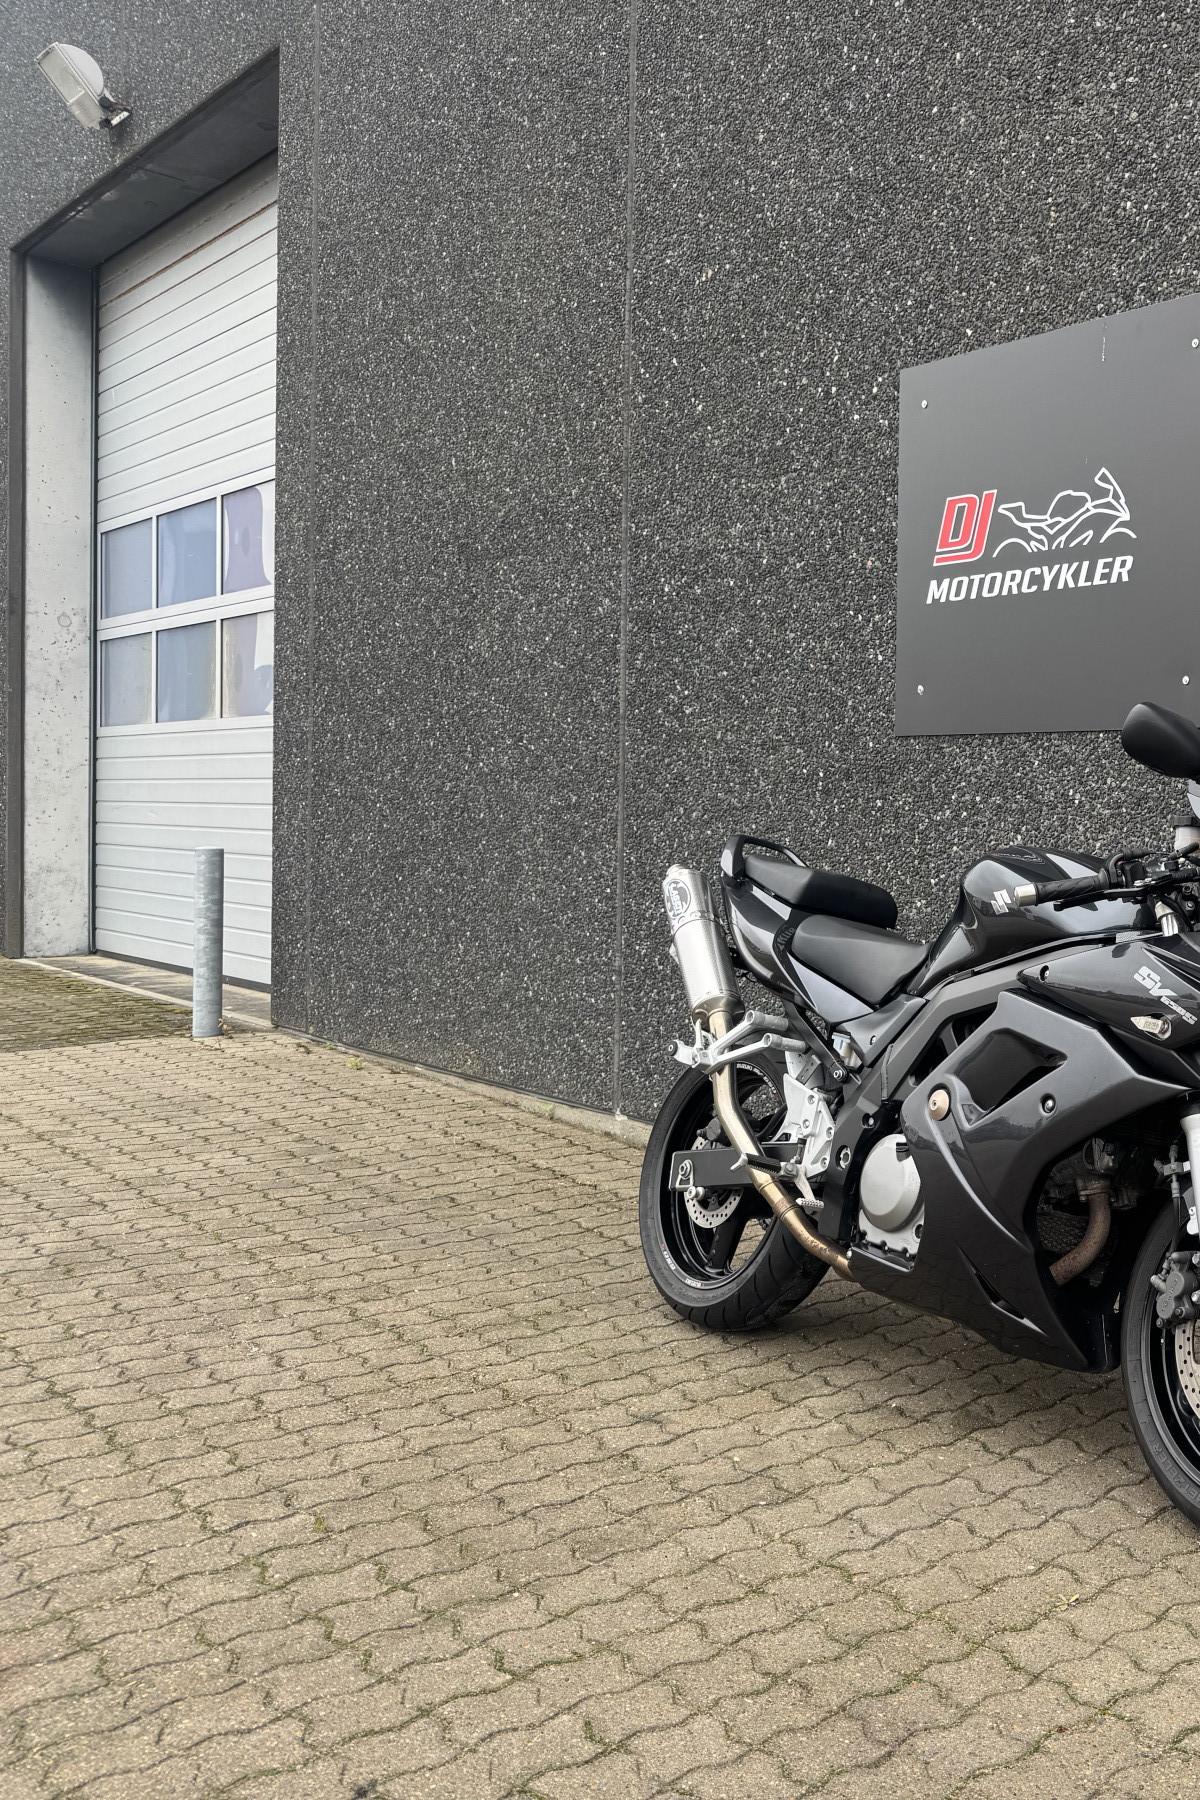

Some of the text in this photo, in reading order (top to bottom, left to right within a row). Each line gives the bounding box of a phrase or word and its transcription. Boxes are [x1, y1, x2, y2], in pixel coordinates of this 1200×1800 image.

[933, 489, 998, 567] DJ
[925, 555, 1134, 604] MOTORCYKLER
[1133, 965, 1178, 997] SV
